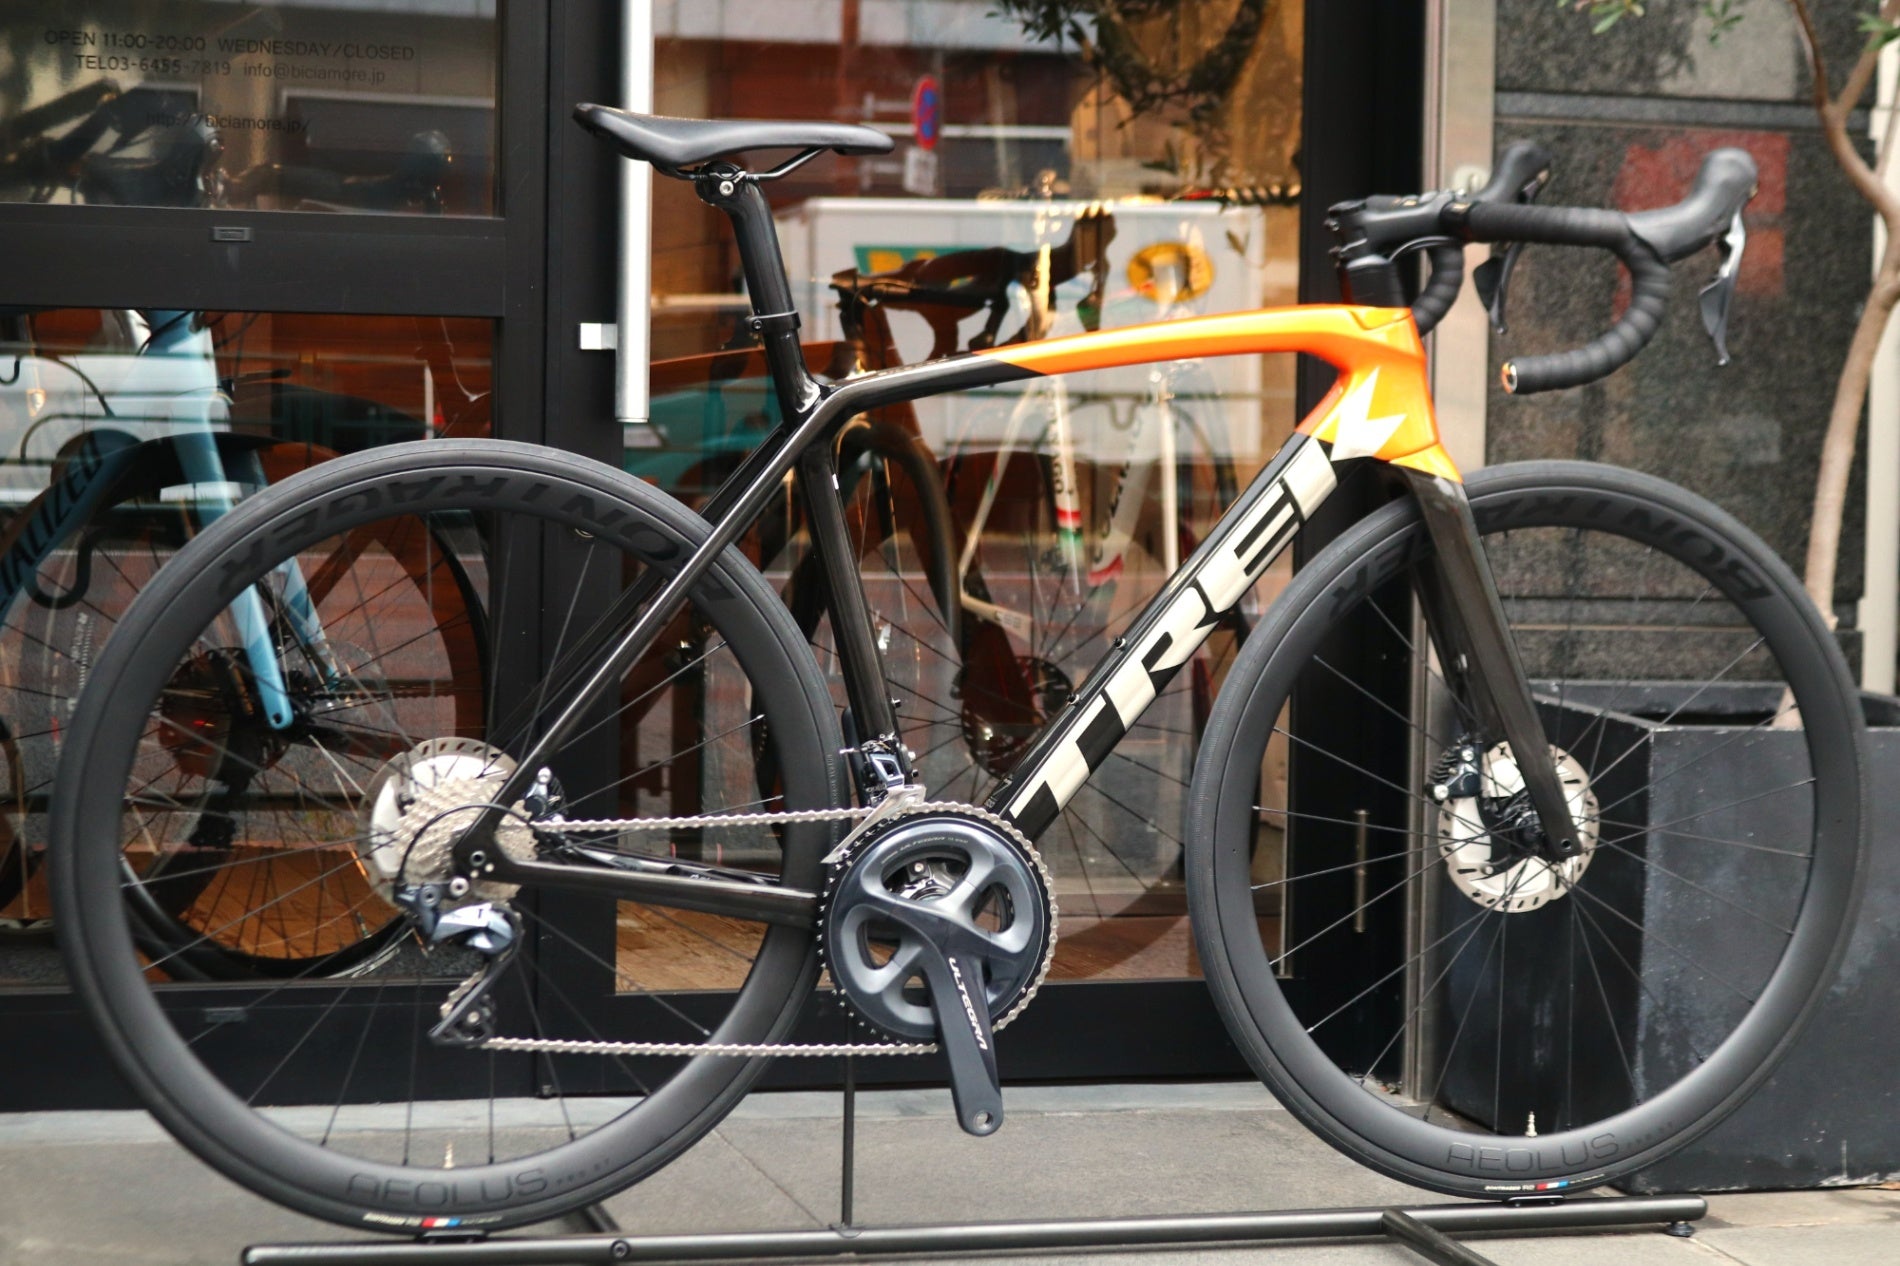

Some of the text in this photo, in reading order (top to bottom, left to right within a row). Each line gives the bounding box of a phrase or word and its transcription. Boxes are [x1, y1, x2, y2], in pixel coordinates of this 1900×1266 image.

[44, 30, 415, 61] OPEN 11:00-20:00 WEDNESDAY/CLOSED
[243, 61, 386, 86] info@biciamore.jp
[1329, 496, 1773, 618] BONTRAER
[1009, 366, 1408, 820] TREK
[948, 956, 988, 1050] ULTEGRA
[1446, 1132, 1620, 1172] AEOLUS
[346, 1167, 549, 1208] AEOLUS
